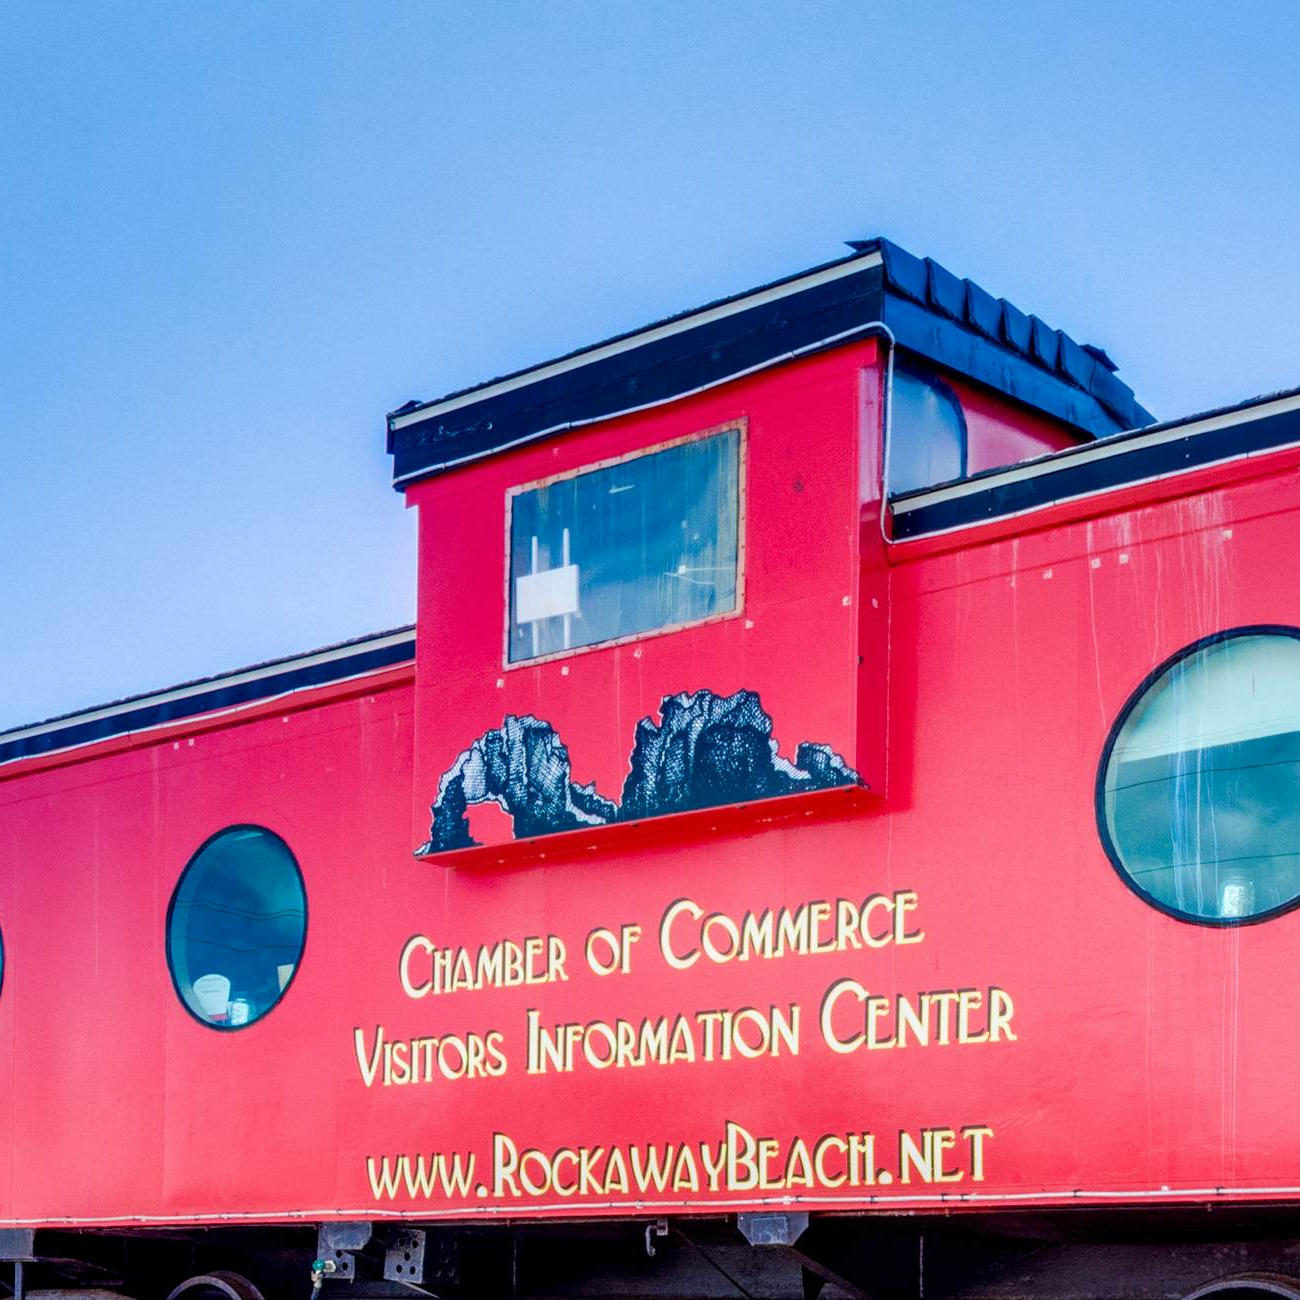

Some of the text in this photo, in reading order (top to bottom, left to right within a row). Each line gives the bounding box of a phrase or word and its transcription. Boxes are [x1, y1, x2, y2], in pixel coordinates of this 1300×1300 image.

[399, 935, 568, 998] CHAMBER
[661, 890, 925, 970] COMMERCE
[354, 977, 1017, 1087] VISITORS INFORMATION CENTER
